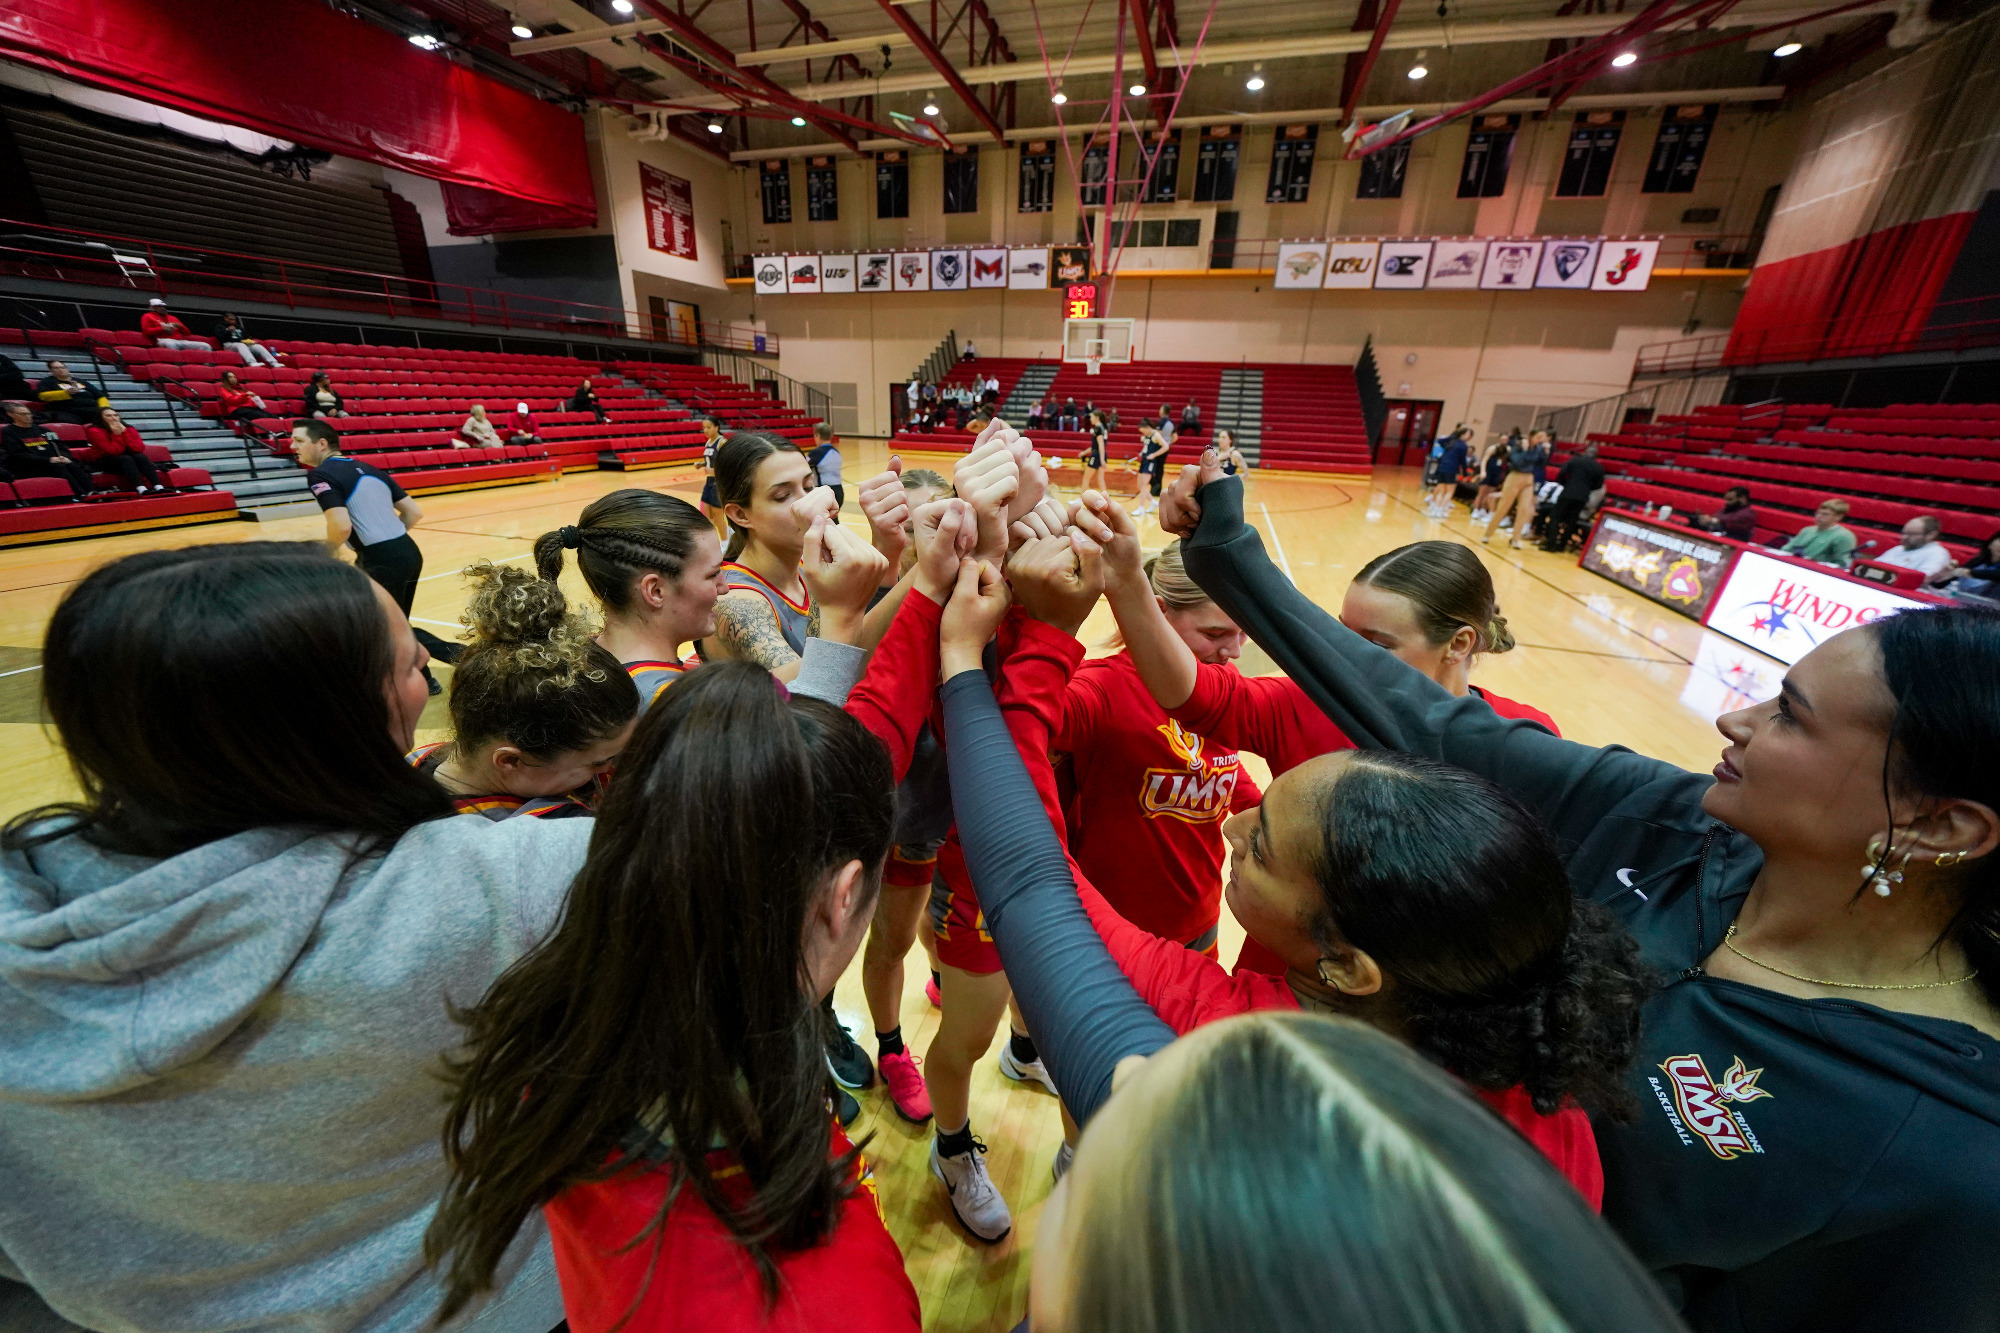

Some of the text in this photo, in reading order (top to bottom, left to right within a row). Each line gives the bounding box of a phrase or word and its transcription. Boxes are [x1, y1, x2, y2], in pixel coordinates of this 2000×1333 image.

[1068, 286, 1096, 299] 10:00
[1070, 301, 1089, 319] 30
[1647, 1076, 1693, 1146] BASKETBALL
[1668, 1058, 1746, 1156] UMSL
[1732, 1110, 1765, 1154] TRITONS
